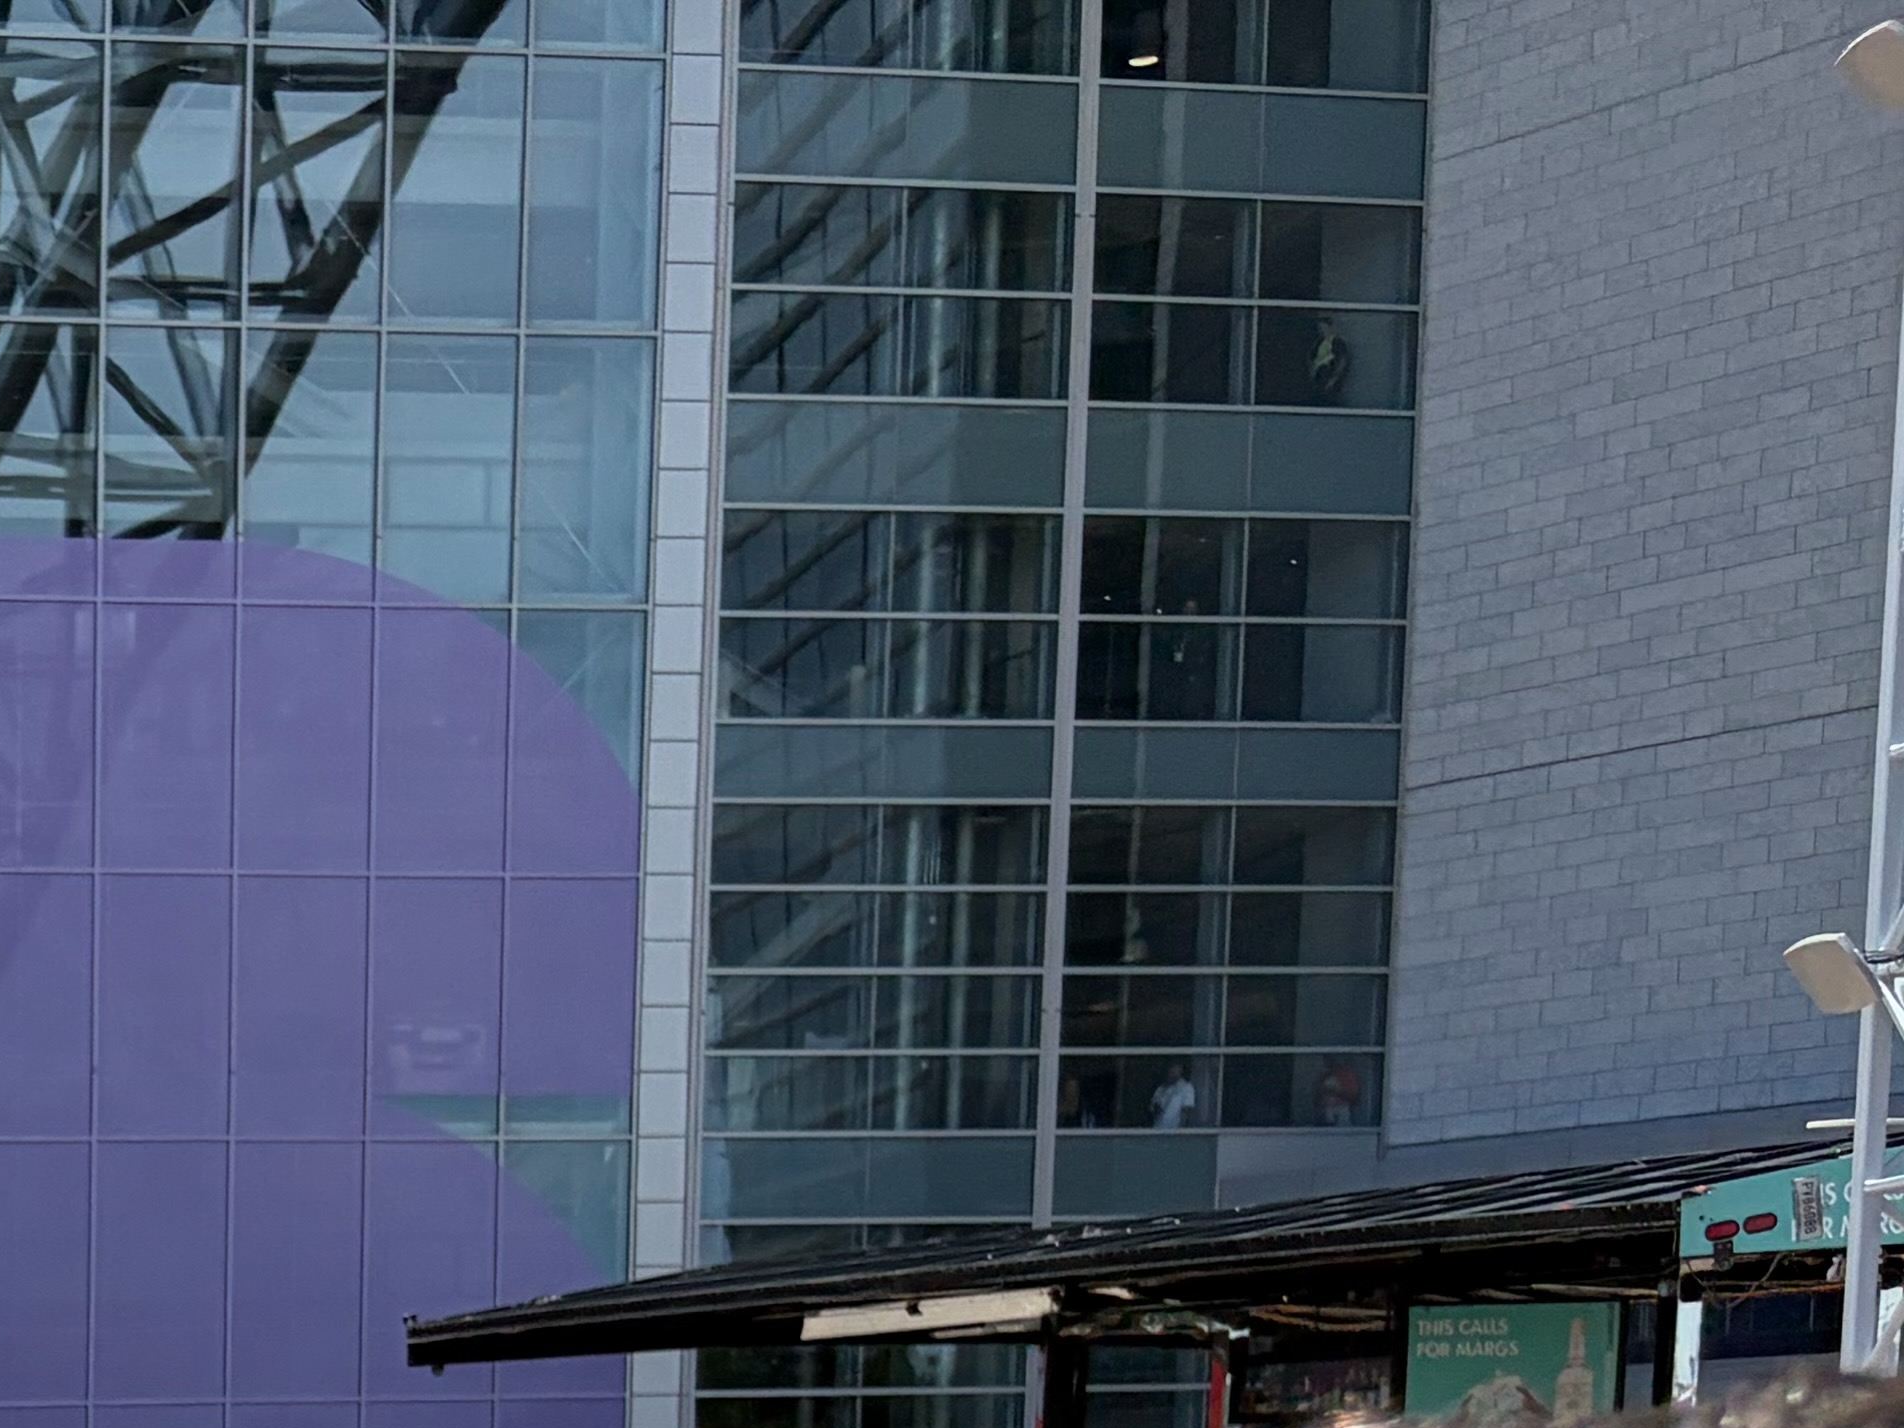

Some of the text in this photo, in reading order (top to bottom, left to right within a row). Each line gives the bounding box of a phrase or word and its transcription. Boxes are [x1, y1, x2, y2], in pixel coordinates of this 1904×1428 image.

[1417, 1317, 1509, 1337] THIS CALLS
[1416, 1340, 1520, 1358] FOR MARGS
